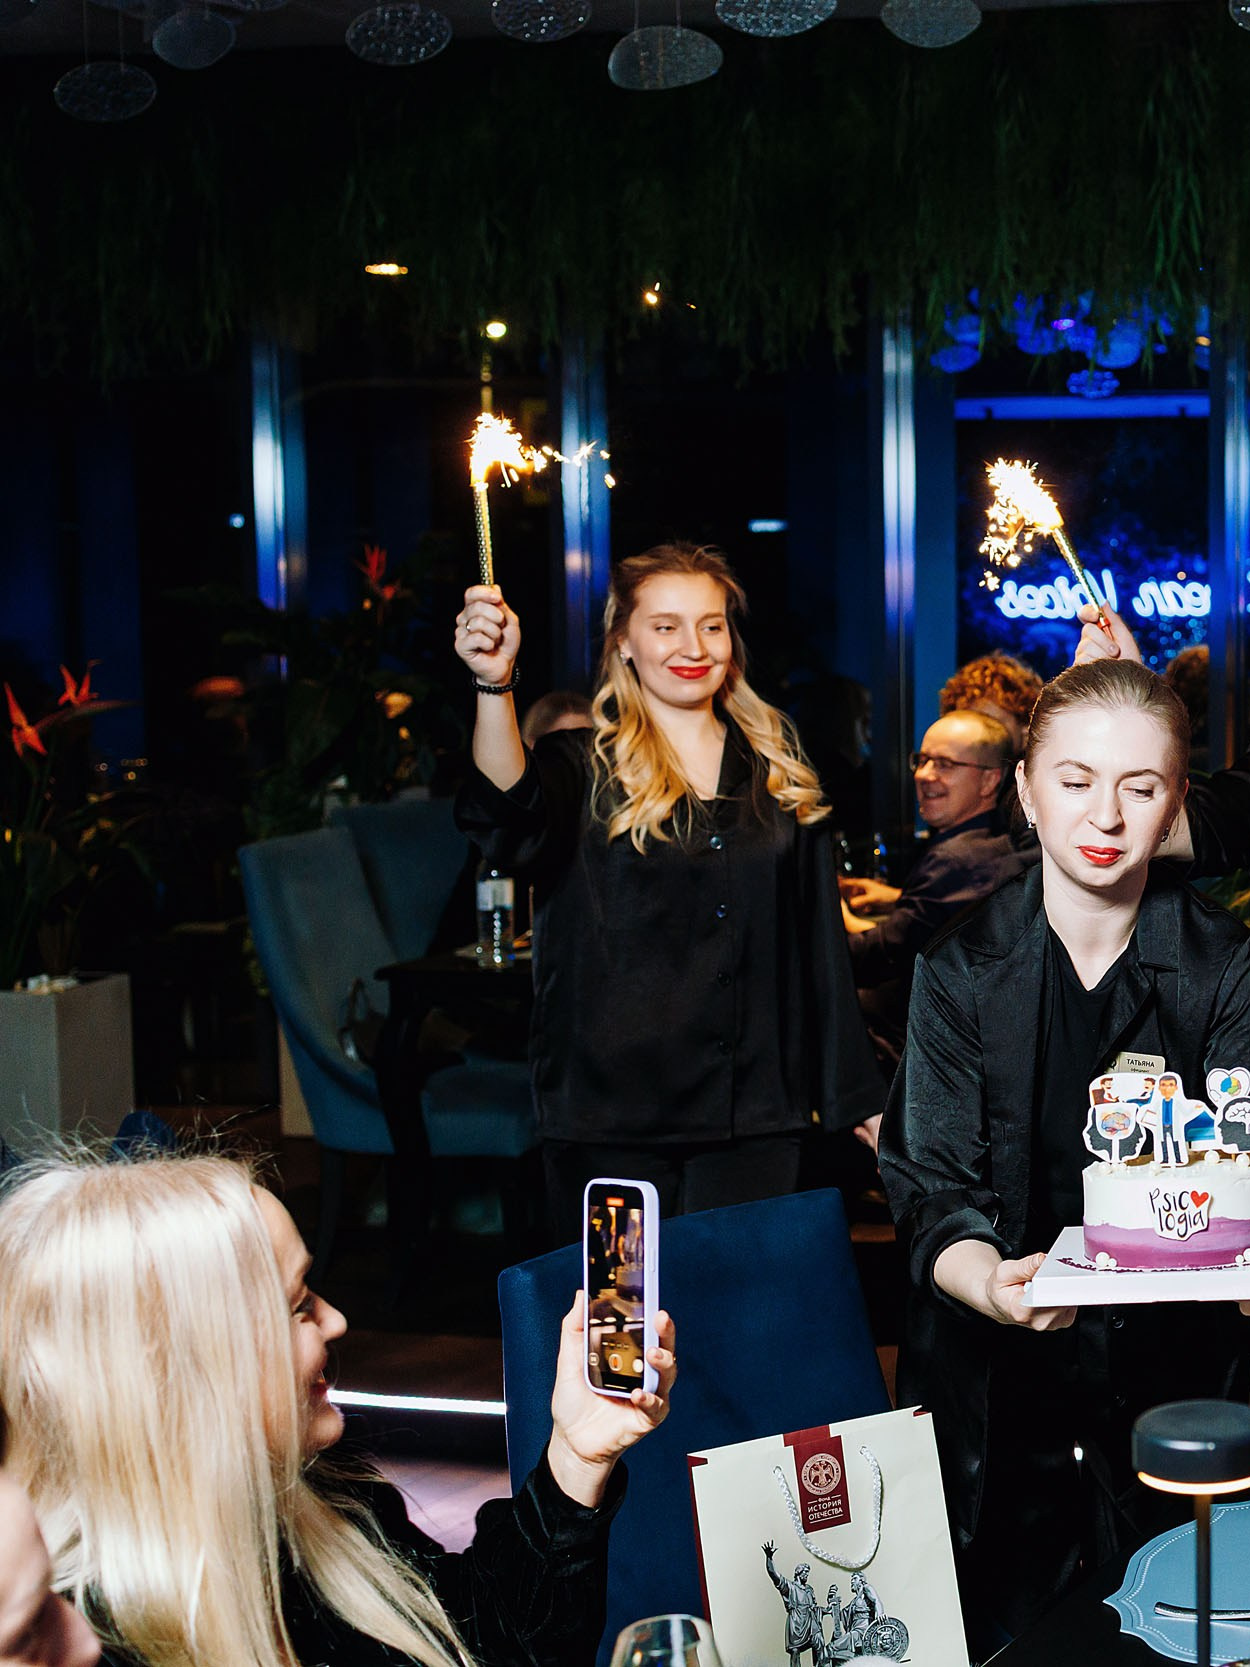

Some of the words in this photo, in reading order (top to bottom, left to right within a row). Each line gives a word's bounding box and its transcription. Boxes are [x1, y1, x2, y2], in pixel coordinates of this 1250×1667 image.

[1126, 1058, 1155, 1068] ТАТЬЯНА
[807, 1499, 842, 1513] ИСТОРИЯ
[808, 1507, 843, 1521] ОТЕЧЕСТВА
